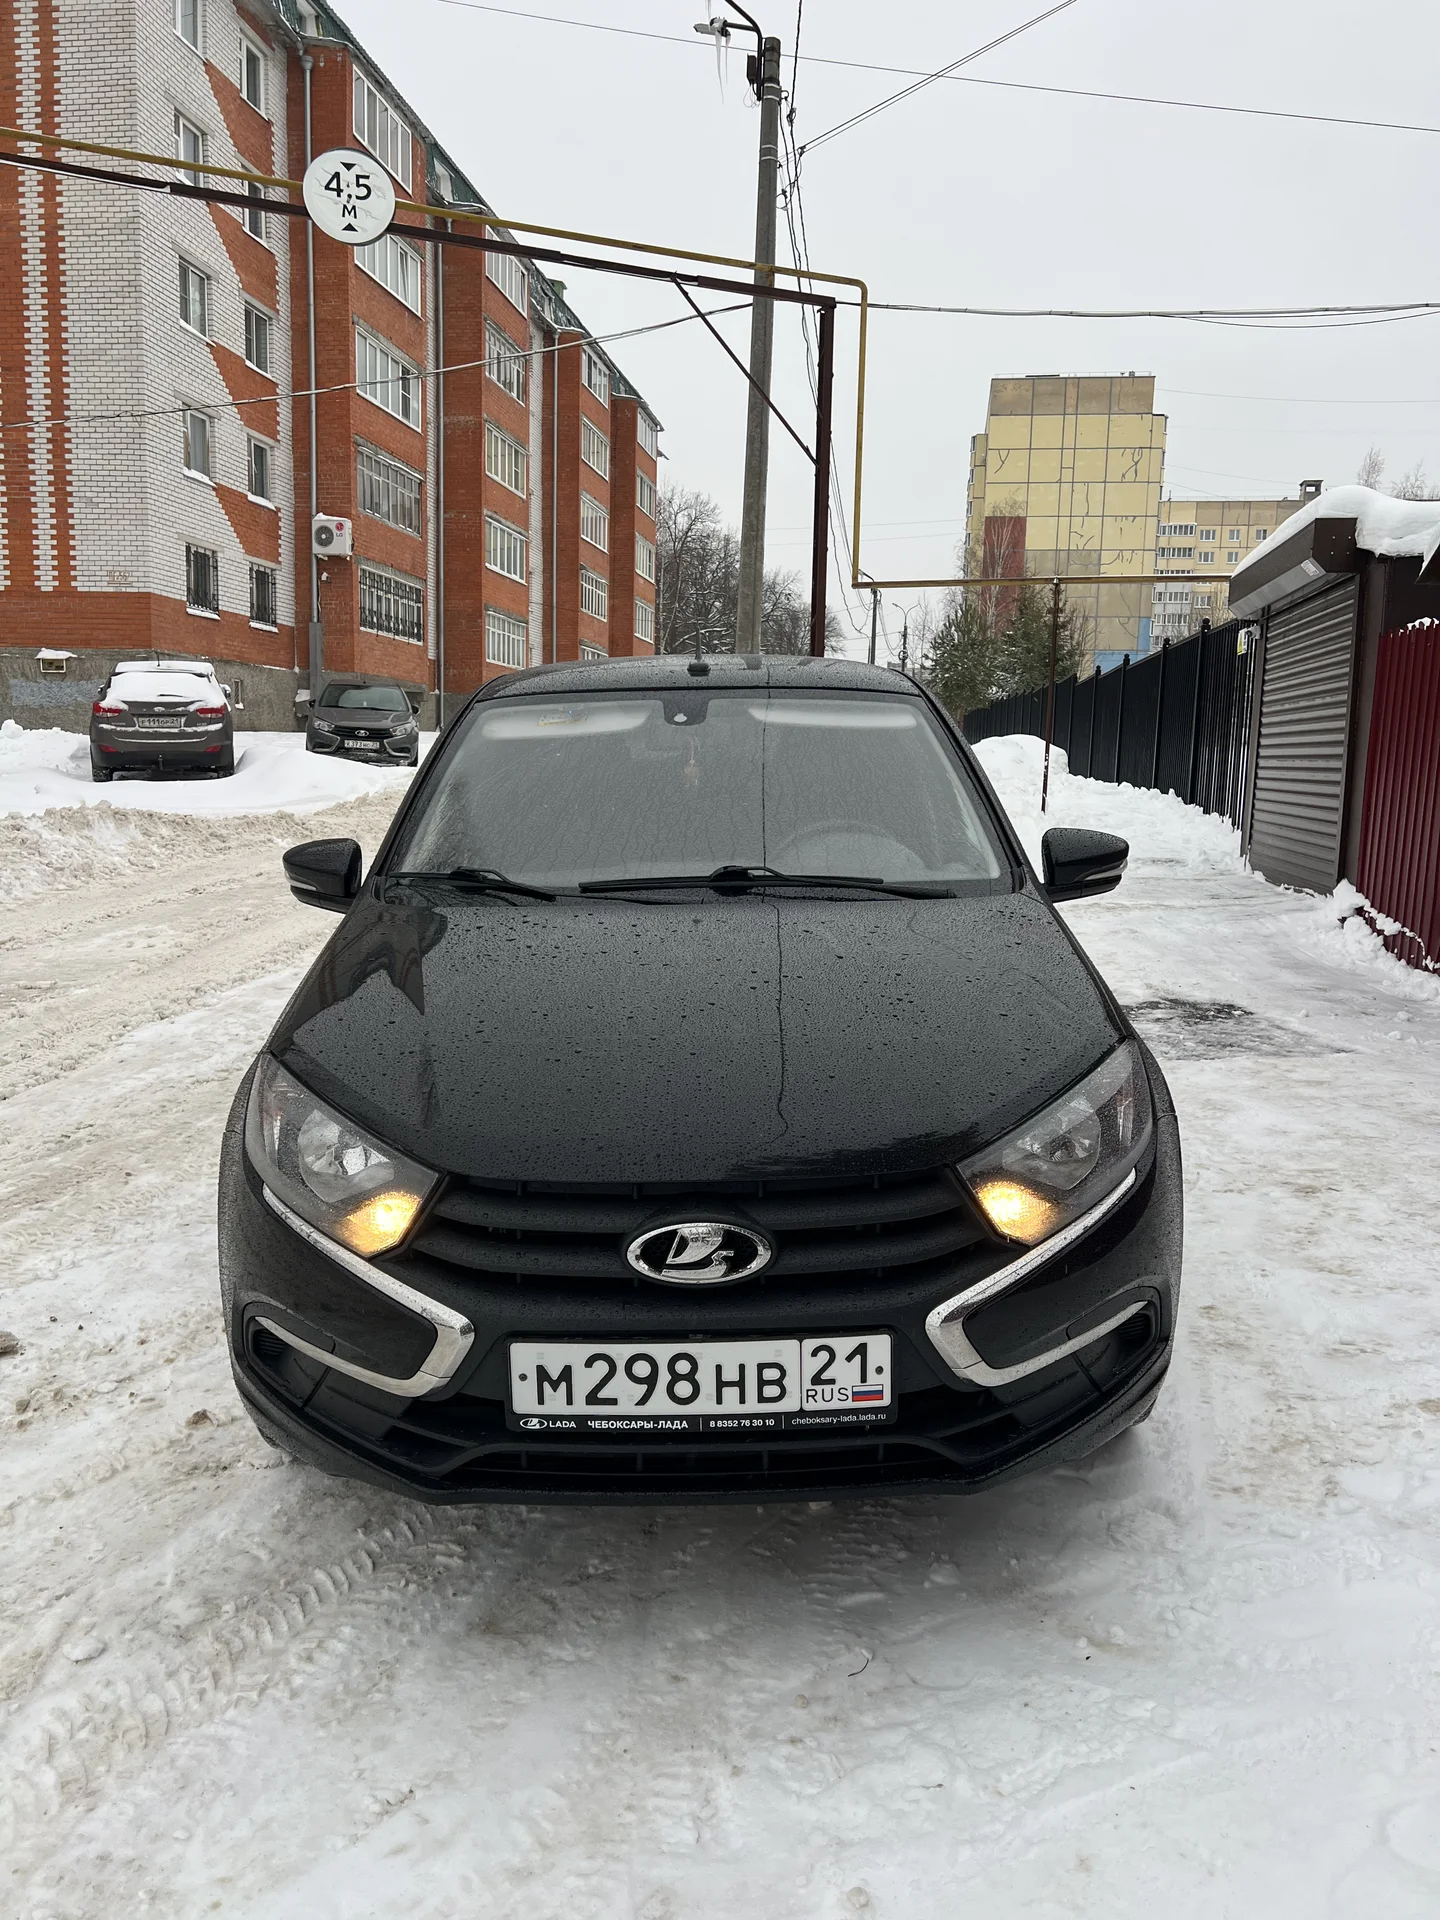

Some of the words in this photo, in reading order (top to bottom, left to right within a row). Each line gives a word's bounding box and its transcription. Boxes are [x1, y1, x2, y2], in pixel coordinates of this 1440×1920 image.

[536, 1352, 787, 1406] М298НВ
[810, 1342, 868, 1386] 21
[805, 1387, 850, 1404] RUS
[549, 1420, 577, 1429] LADA
[587, 1420, 689, 1430] ЧЕБОКСАРЫ-ЛАДА
[709, 1420, 716, 1428] 8
[717, 1420, 738, 1428] 8352
[740, 1420, 751, 1428] 76
[752, 1419, 763, 1428] 30
[764, 1418, 775, 1426] 10
[791, 1412, 887, 1426] cheboksary-lada.lada.ru
